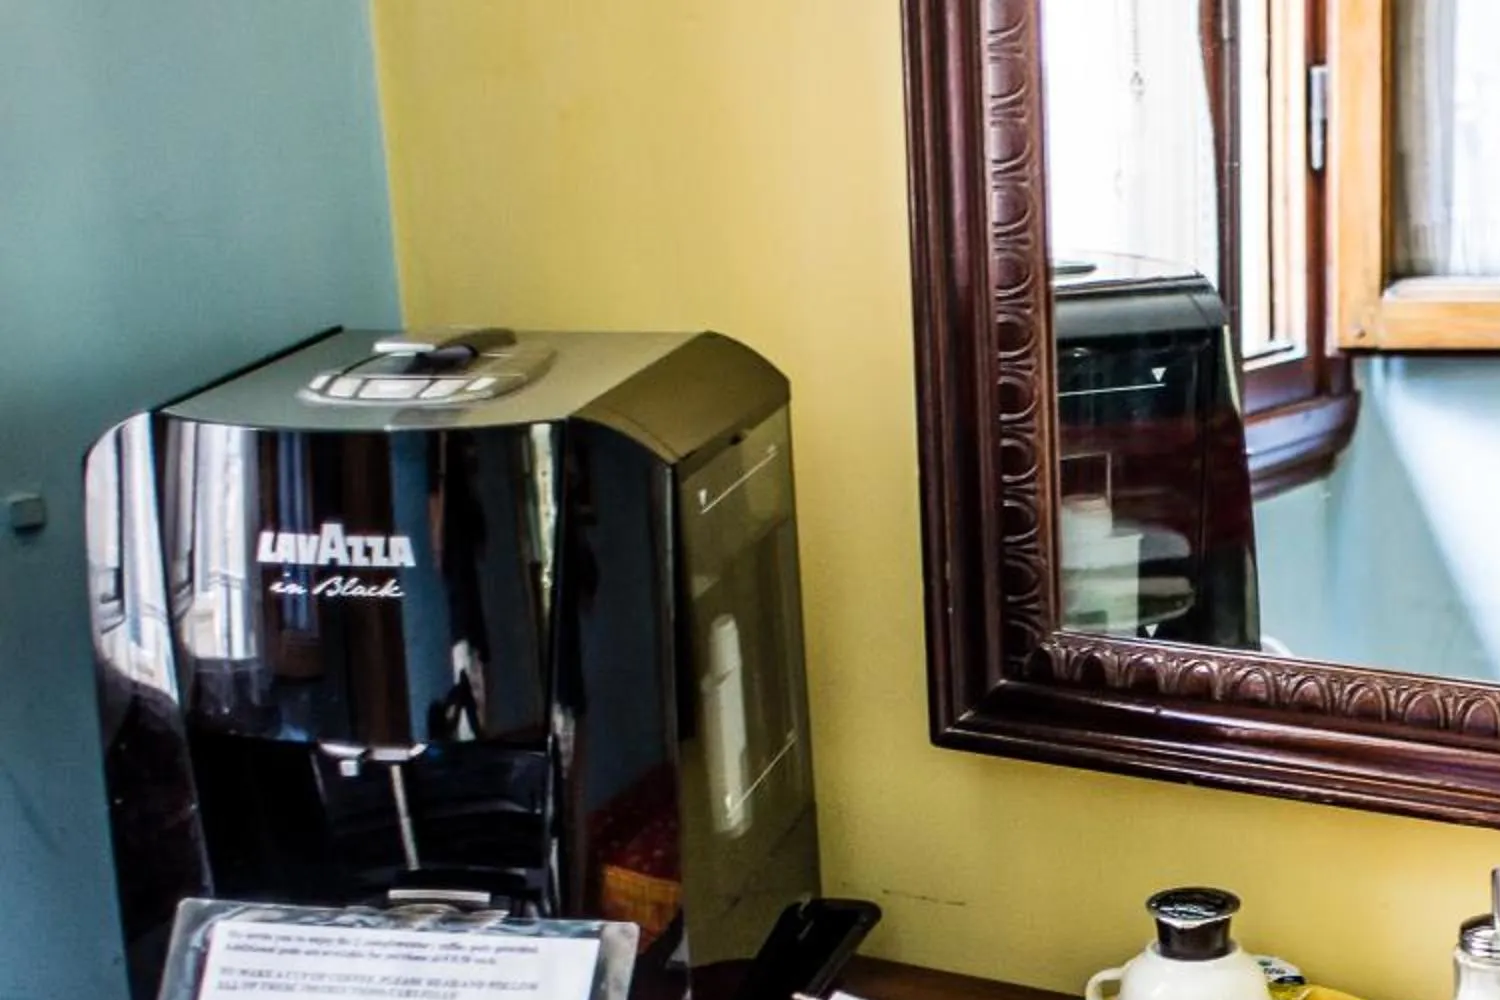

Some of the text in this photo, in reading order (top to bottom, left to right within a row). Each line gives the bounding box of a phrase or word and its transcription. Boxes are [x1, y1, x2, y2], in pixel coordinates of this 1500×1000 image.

[257, 523, 416, 567] LAVAZZA
[269, 573, 405, 597] in Black
